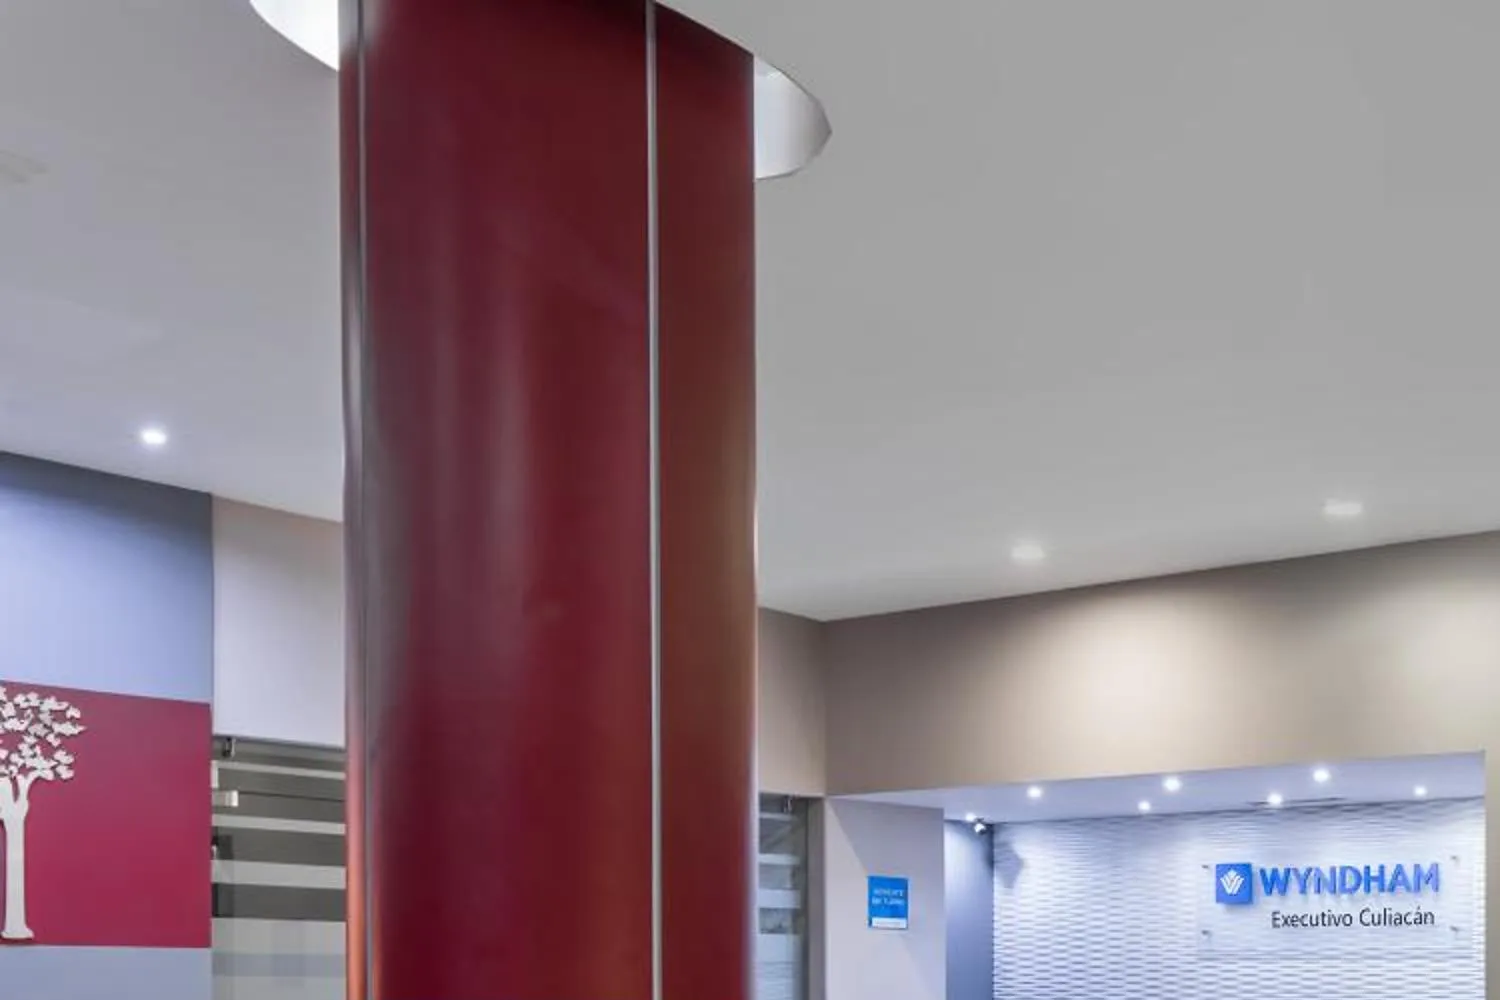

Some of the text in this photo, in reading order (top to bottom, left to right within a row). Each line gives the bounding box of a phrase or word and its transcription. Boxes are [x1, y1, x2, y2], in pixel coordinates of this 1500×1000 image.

[1259, 863, 1440, 896] WYNDHAM
[1271, 906, 1435, 928] Executivo Culiacán
